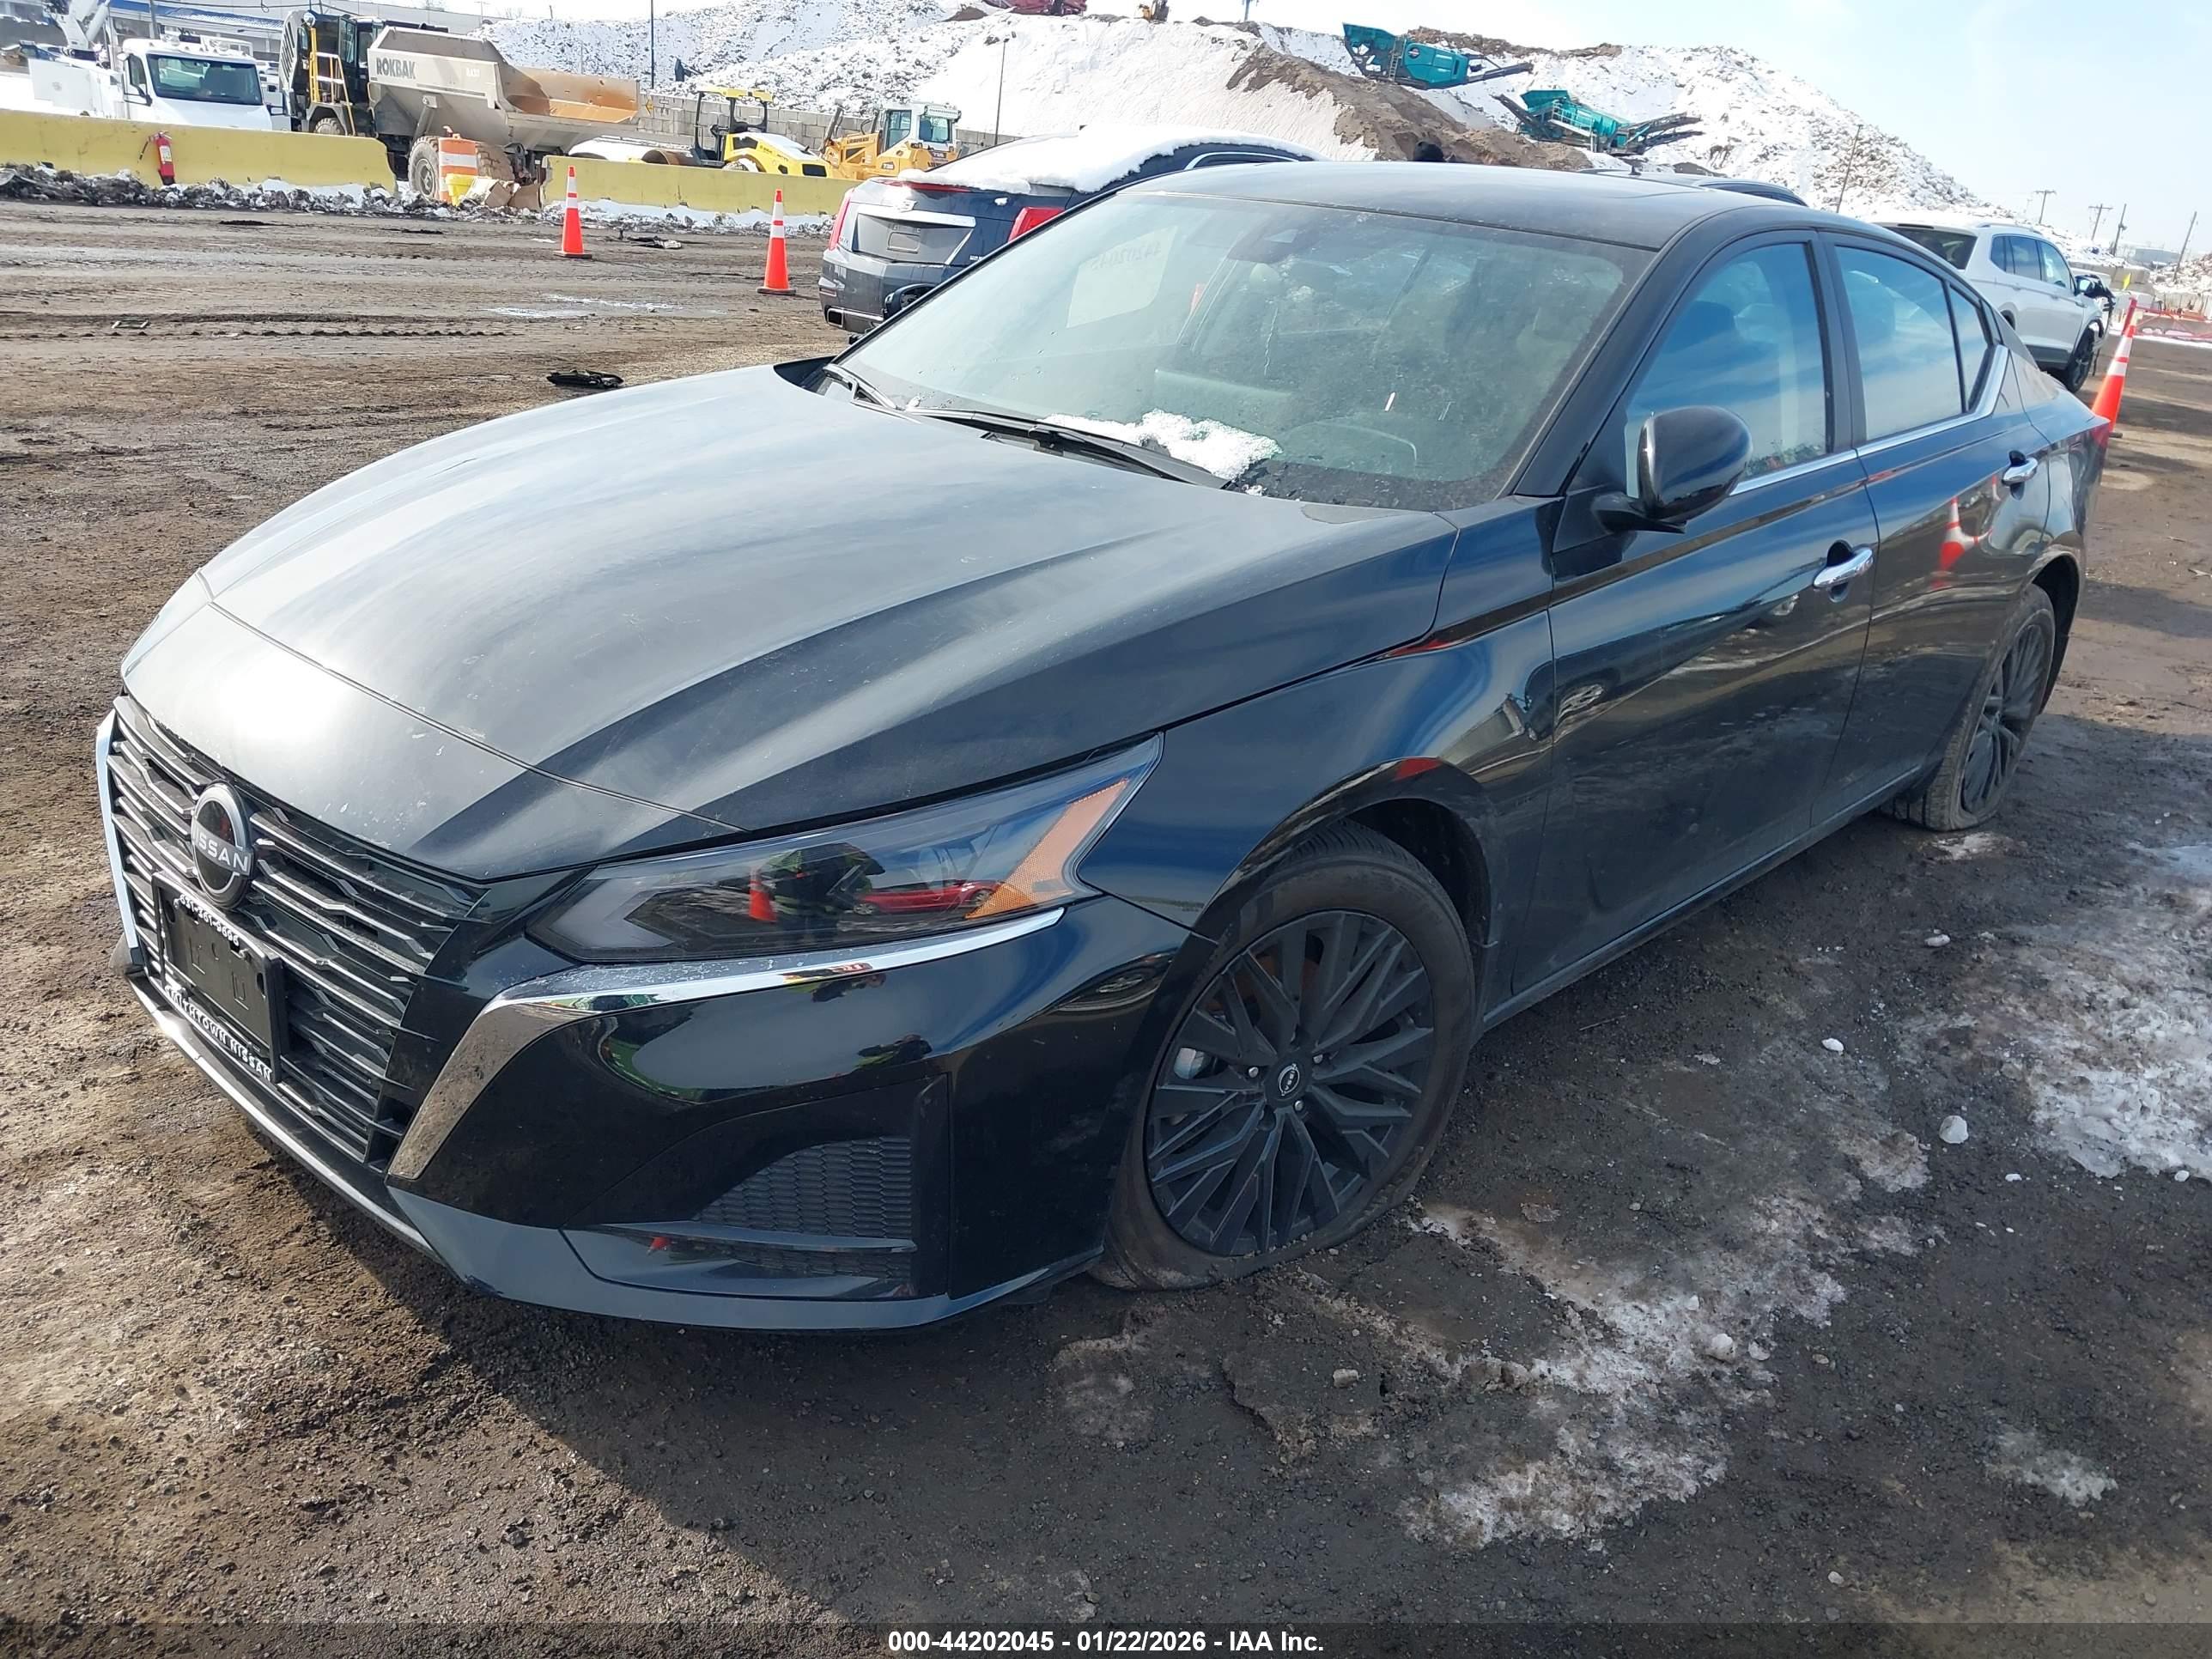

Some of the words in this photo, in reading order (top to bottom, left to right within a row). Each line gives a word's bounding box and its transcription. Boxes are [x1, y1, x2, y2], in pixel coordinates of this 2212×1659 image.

[376, 58, 416, 80] ROKBAK
[191, 821, 248, 872] NISSAN
[164, 984, 227, 1044] SMITHTOWN
[230, 1037, 273, 1082] NISSAN
